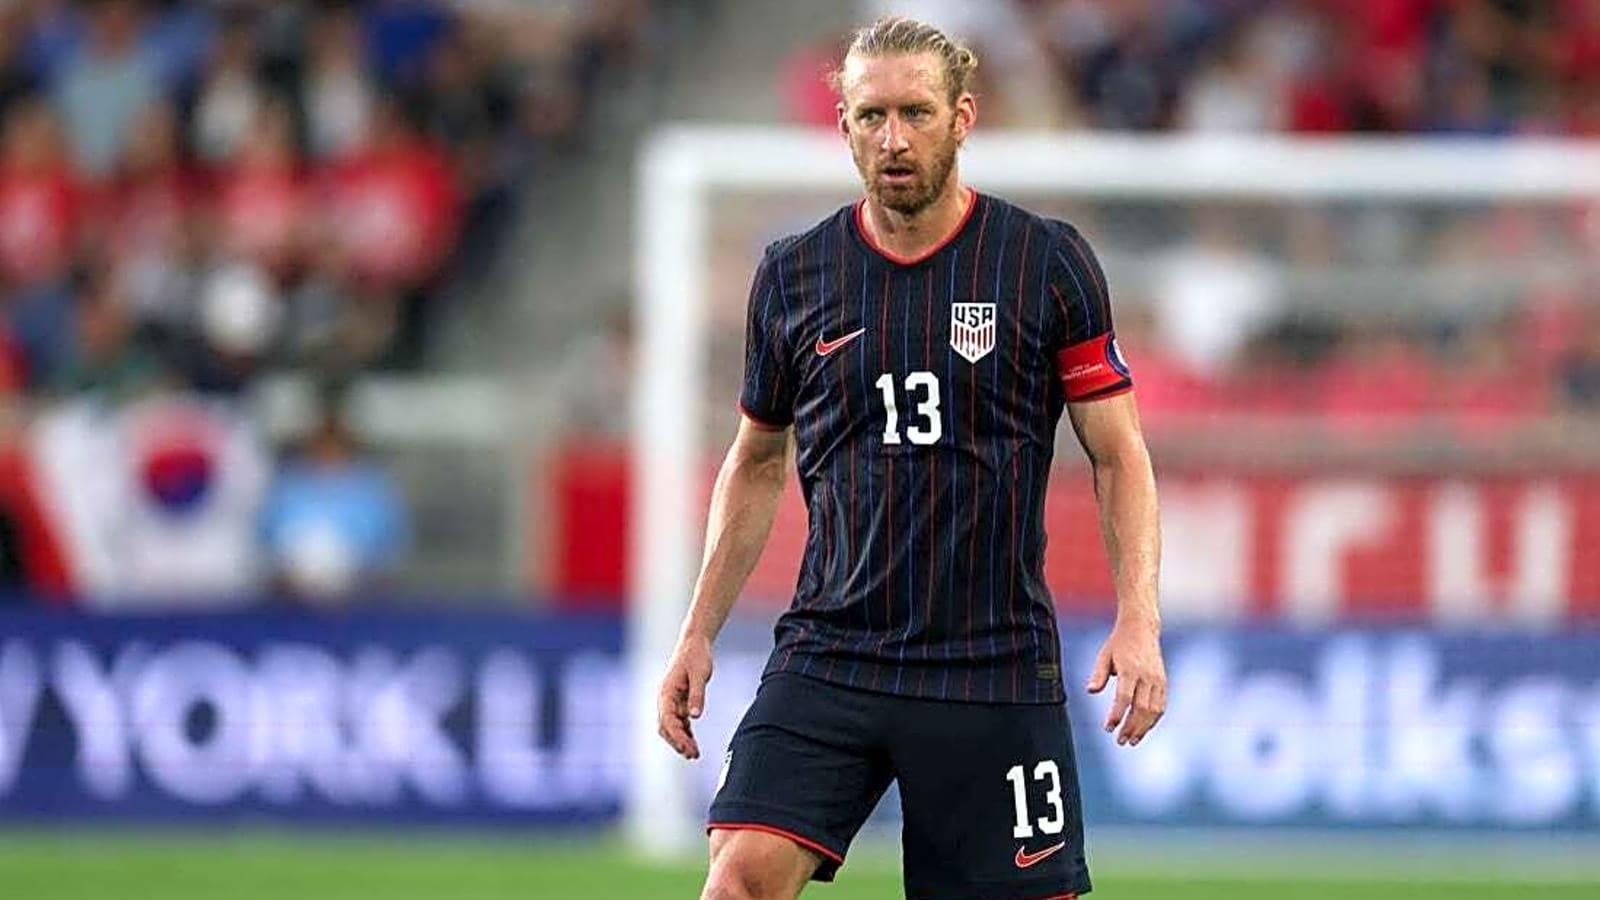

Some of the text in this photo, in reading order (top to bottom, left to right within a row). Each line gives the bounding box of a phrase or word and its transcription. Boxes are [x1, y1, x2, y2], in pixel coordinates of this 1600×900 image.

[954, 306, 993, 328] USA
[875, 371, 942, 445] 13
[51, 637, 468, 804] YORK
[1080, 632, 1600, 822] Volks
[1006, 760, 1065, 838] 13
